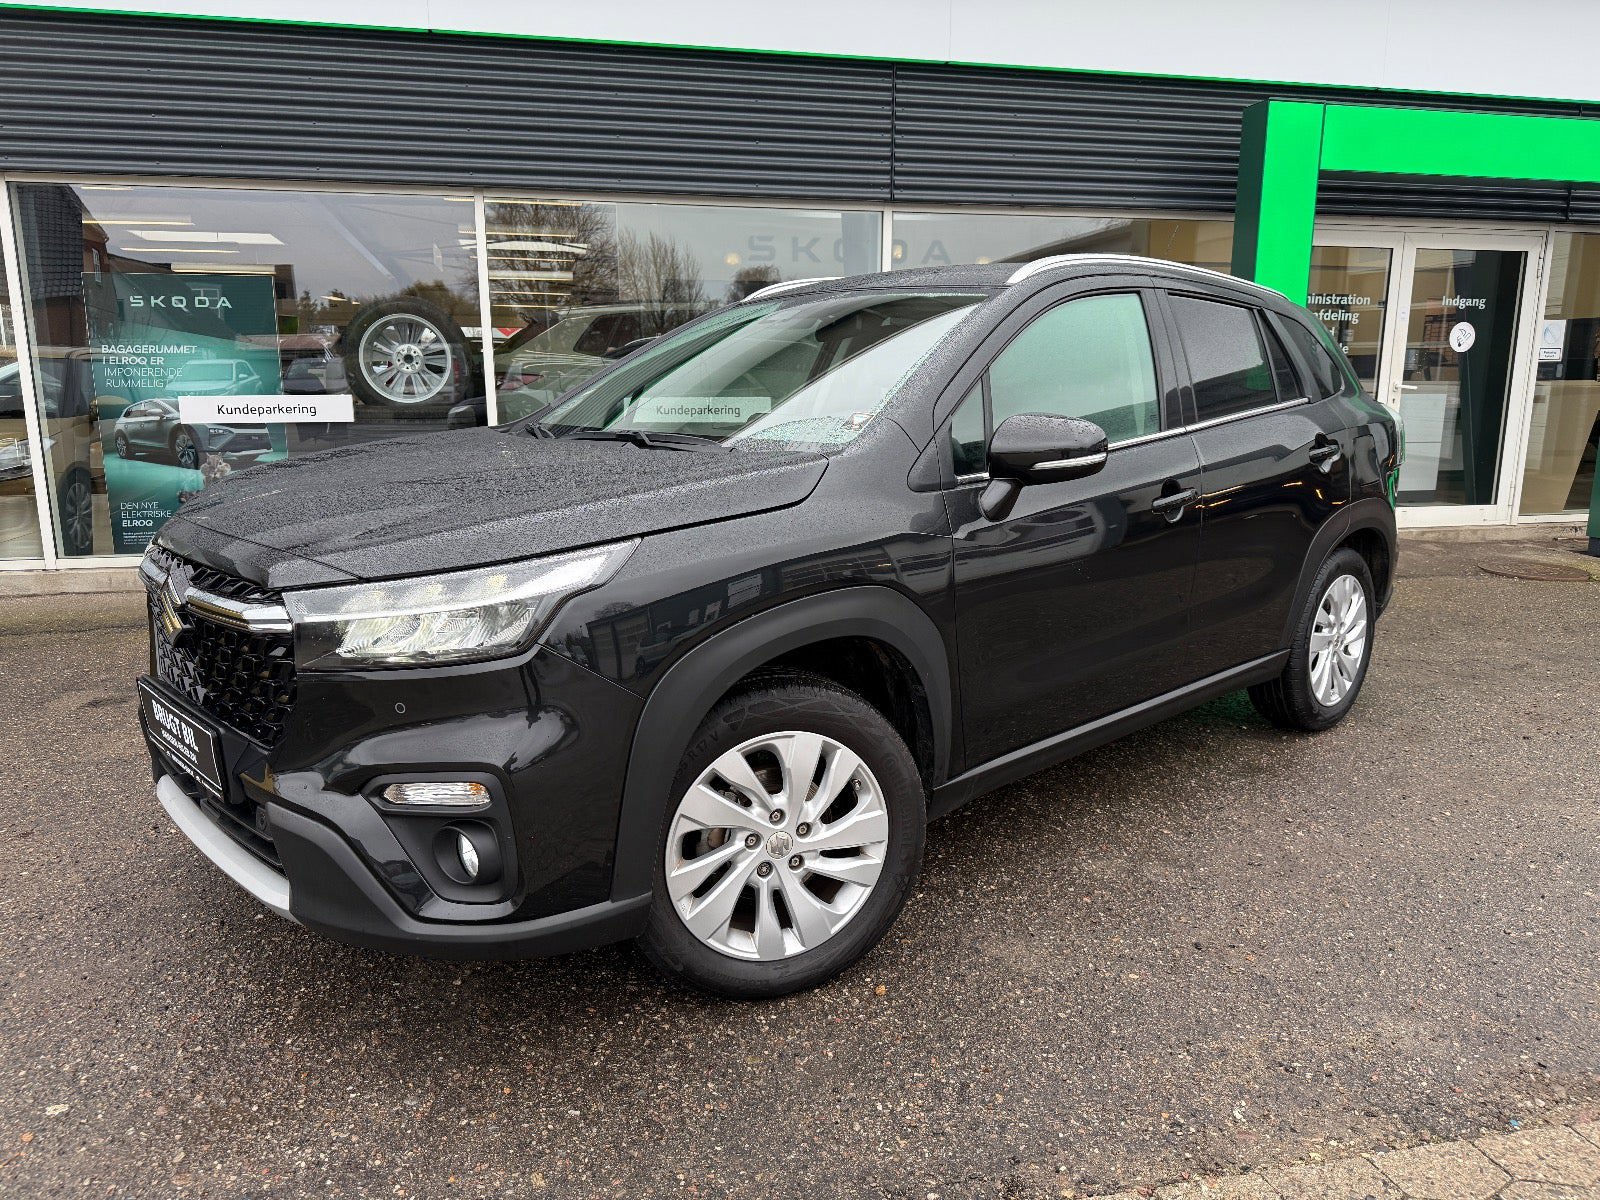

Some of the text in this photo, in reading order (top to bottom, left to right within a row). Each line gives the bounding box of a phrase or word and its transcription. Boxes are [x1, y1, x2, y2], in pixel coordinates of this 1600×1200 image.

[1441, 294, 1487, 310] Indgang
[101, 344, 198, 354] BAGAGERUMMET
[102, 355, 165, 365] I ELROQ ER
[104, 367, 183, 377] IMPONERENDE
[105, 378, 171, 388] RUMMELIGT
[217, 403, 317, 417] Kundeparkering
[656, 404, 741, 418] Kundeparkering
[120, 501, 159, 510] DEN NYE
[121, 510, 172, 519] ELEKTRISKE
[122, 519, 154, 527] ELROQ
[151, 699, 182, 739] BRUGT
[180, 721, 200, 753] BIL
